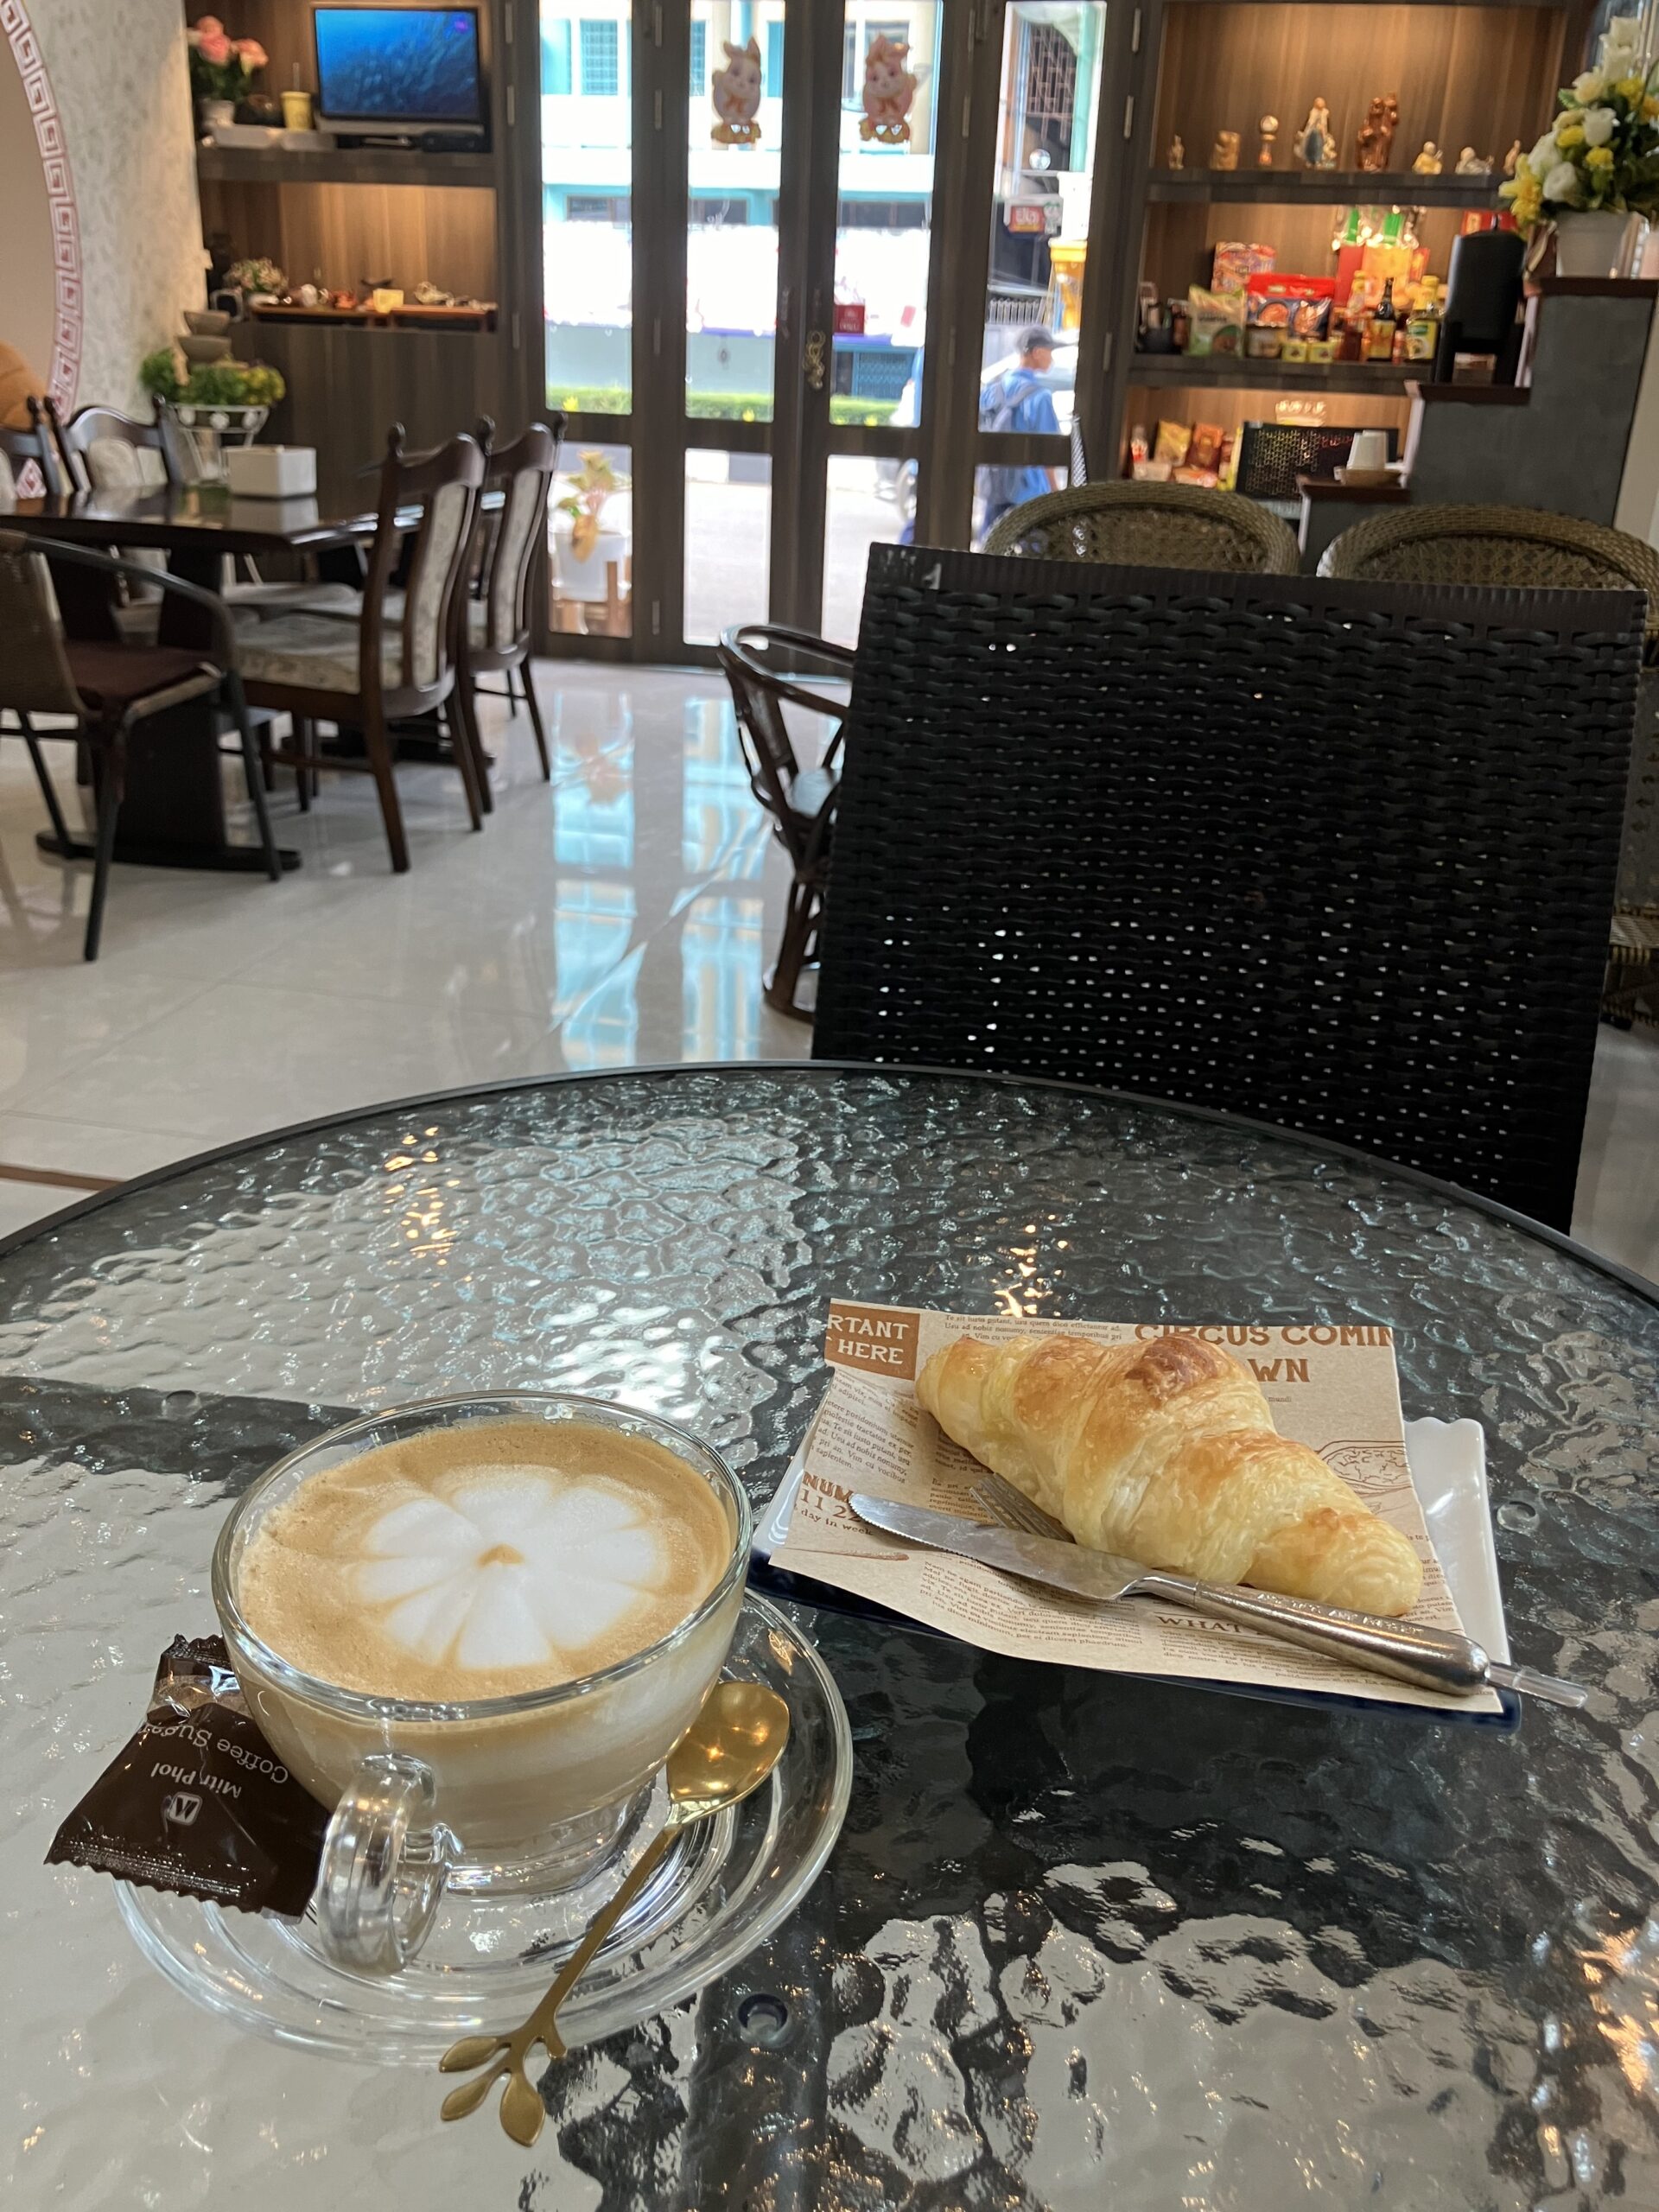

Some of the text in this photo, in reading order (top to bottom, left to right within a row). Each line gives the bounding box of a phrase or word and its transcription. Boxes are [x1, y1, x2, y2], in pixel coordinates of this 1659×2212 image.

[828, 1314, 910, 1340] RTANT
[837, 1339, 904, 1364] HERE
[1247, 1358, 1311, 1382] WN
[801, 1508, 822, 1522] day
[1156, 1616, 1242, 1633] WHAT
[216, 1738, 289, 1784] Coffee
[150, 1761, 242, 1798] Mitr Phol
